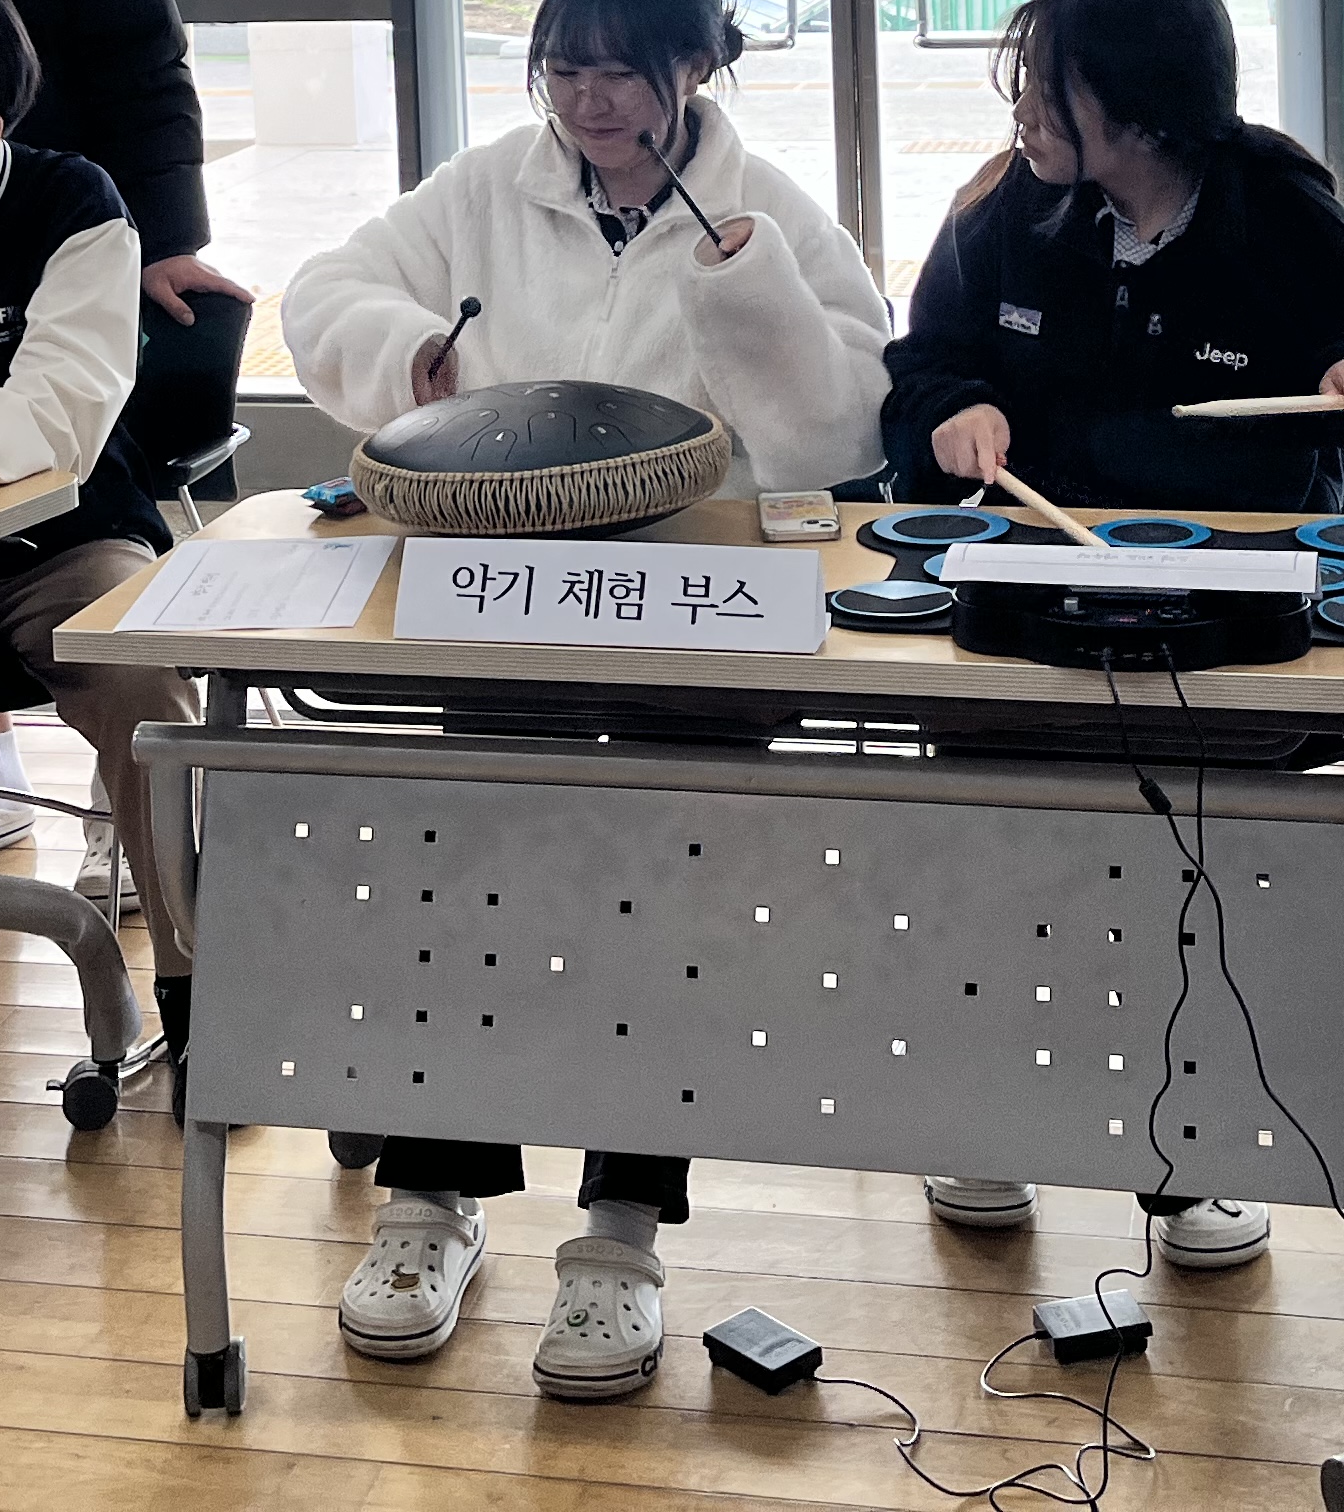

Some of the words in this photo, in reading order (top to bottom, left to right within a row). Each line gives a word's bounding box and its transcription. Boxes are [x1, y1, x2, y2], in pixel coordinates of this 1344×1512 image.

[1195, 342, 1249, 371] Jeep
[452, 562, 535, 615] 악기
[558, 568, 646, 620] 체험
[671, 575, 764, 625] 부스
